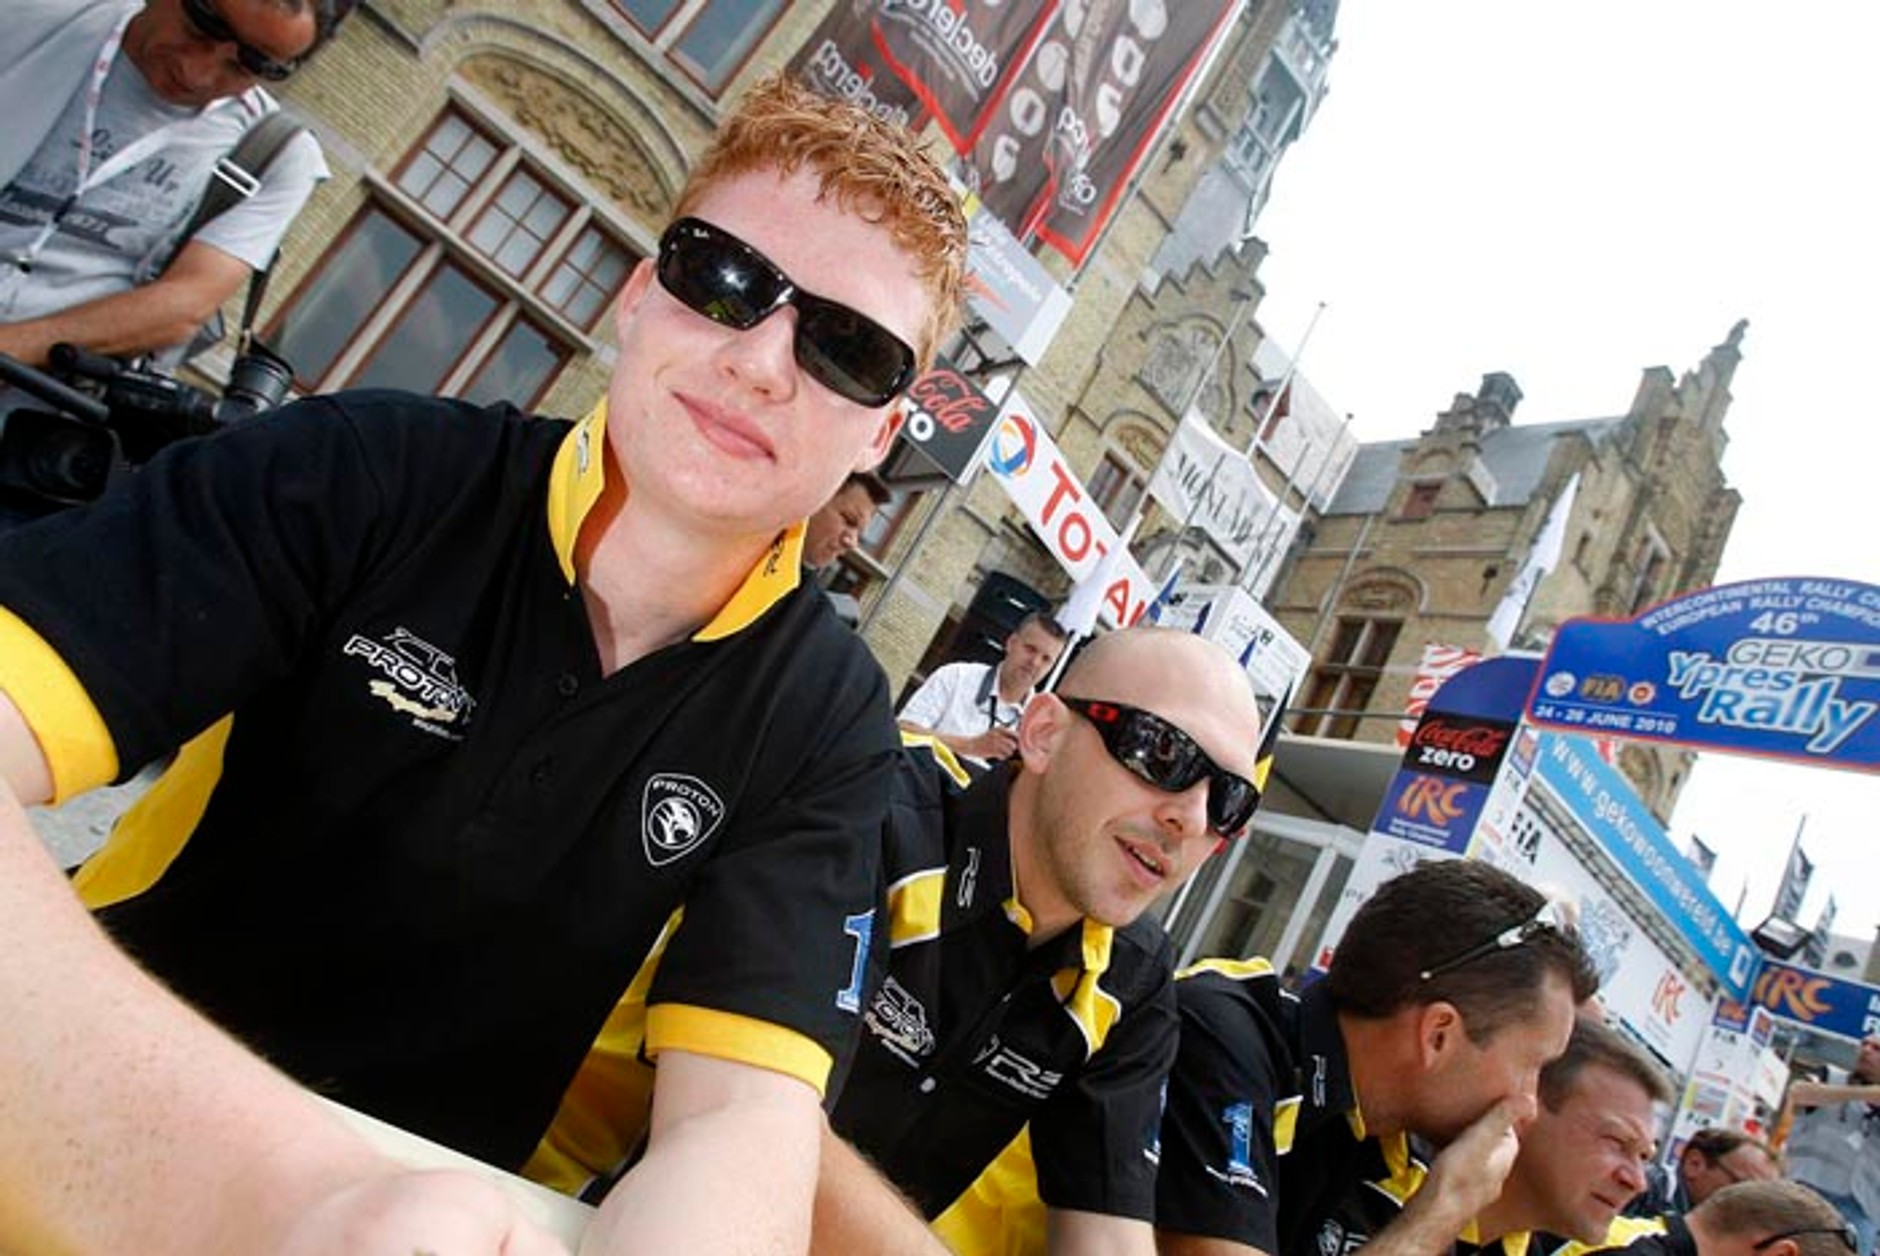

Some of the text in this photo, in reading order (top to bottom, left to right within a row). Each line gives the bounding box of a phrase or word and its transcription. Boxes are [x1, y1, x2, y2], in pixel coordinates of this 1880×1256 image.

[1800, 581, 1857, 602] RALLY
[1656, 599, 1742, 636] EUROPEAN
[1750, 595, 1804, 609] RALLY
[1731, 641, 1851, 671] GEKO
[1667, 651, 1801, 699] Ypres
[1587, 711, 1632, 727] JUNE
[1635, 716, 1677, 734] 2010
[1698, 677, 1877, 753] Rally
[1419, 746, 1476, 772] zero
[652, 781, 720, 817] PROTON
